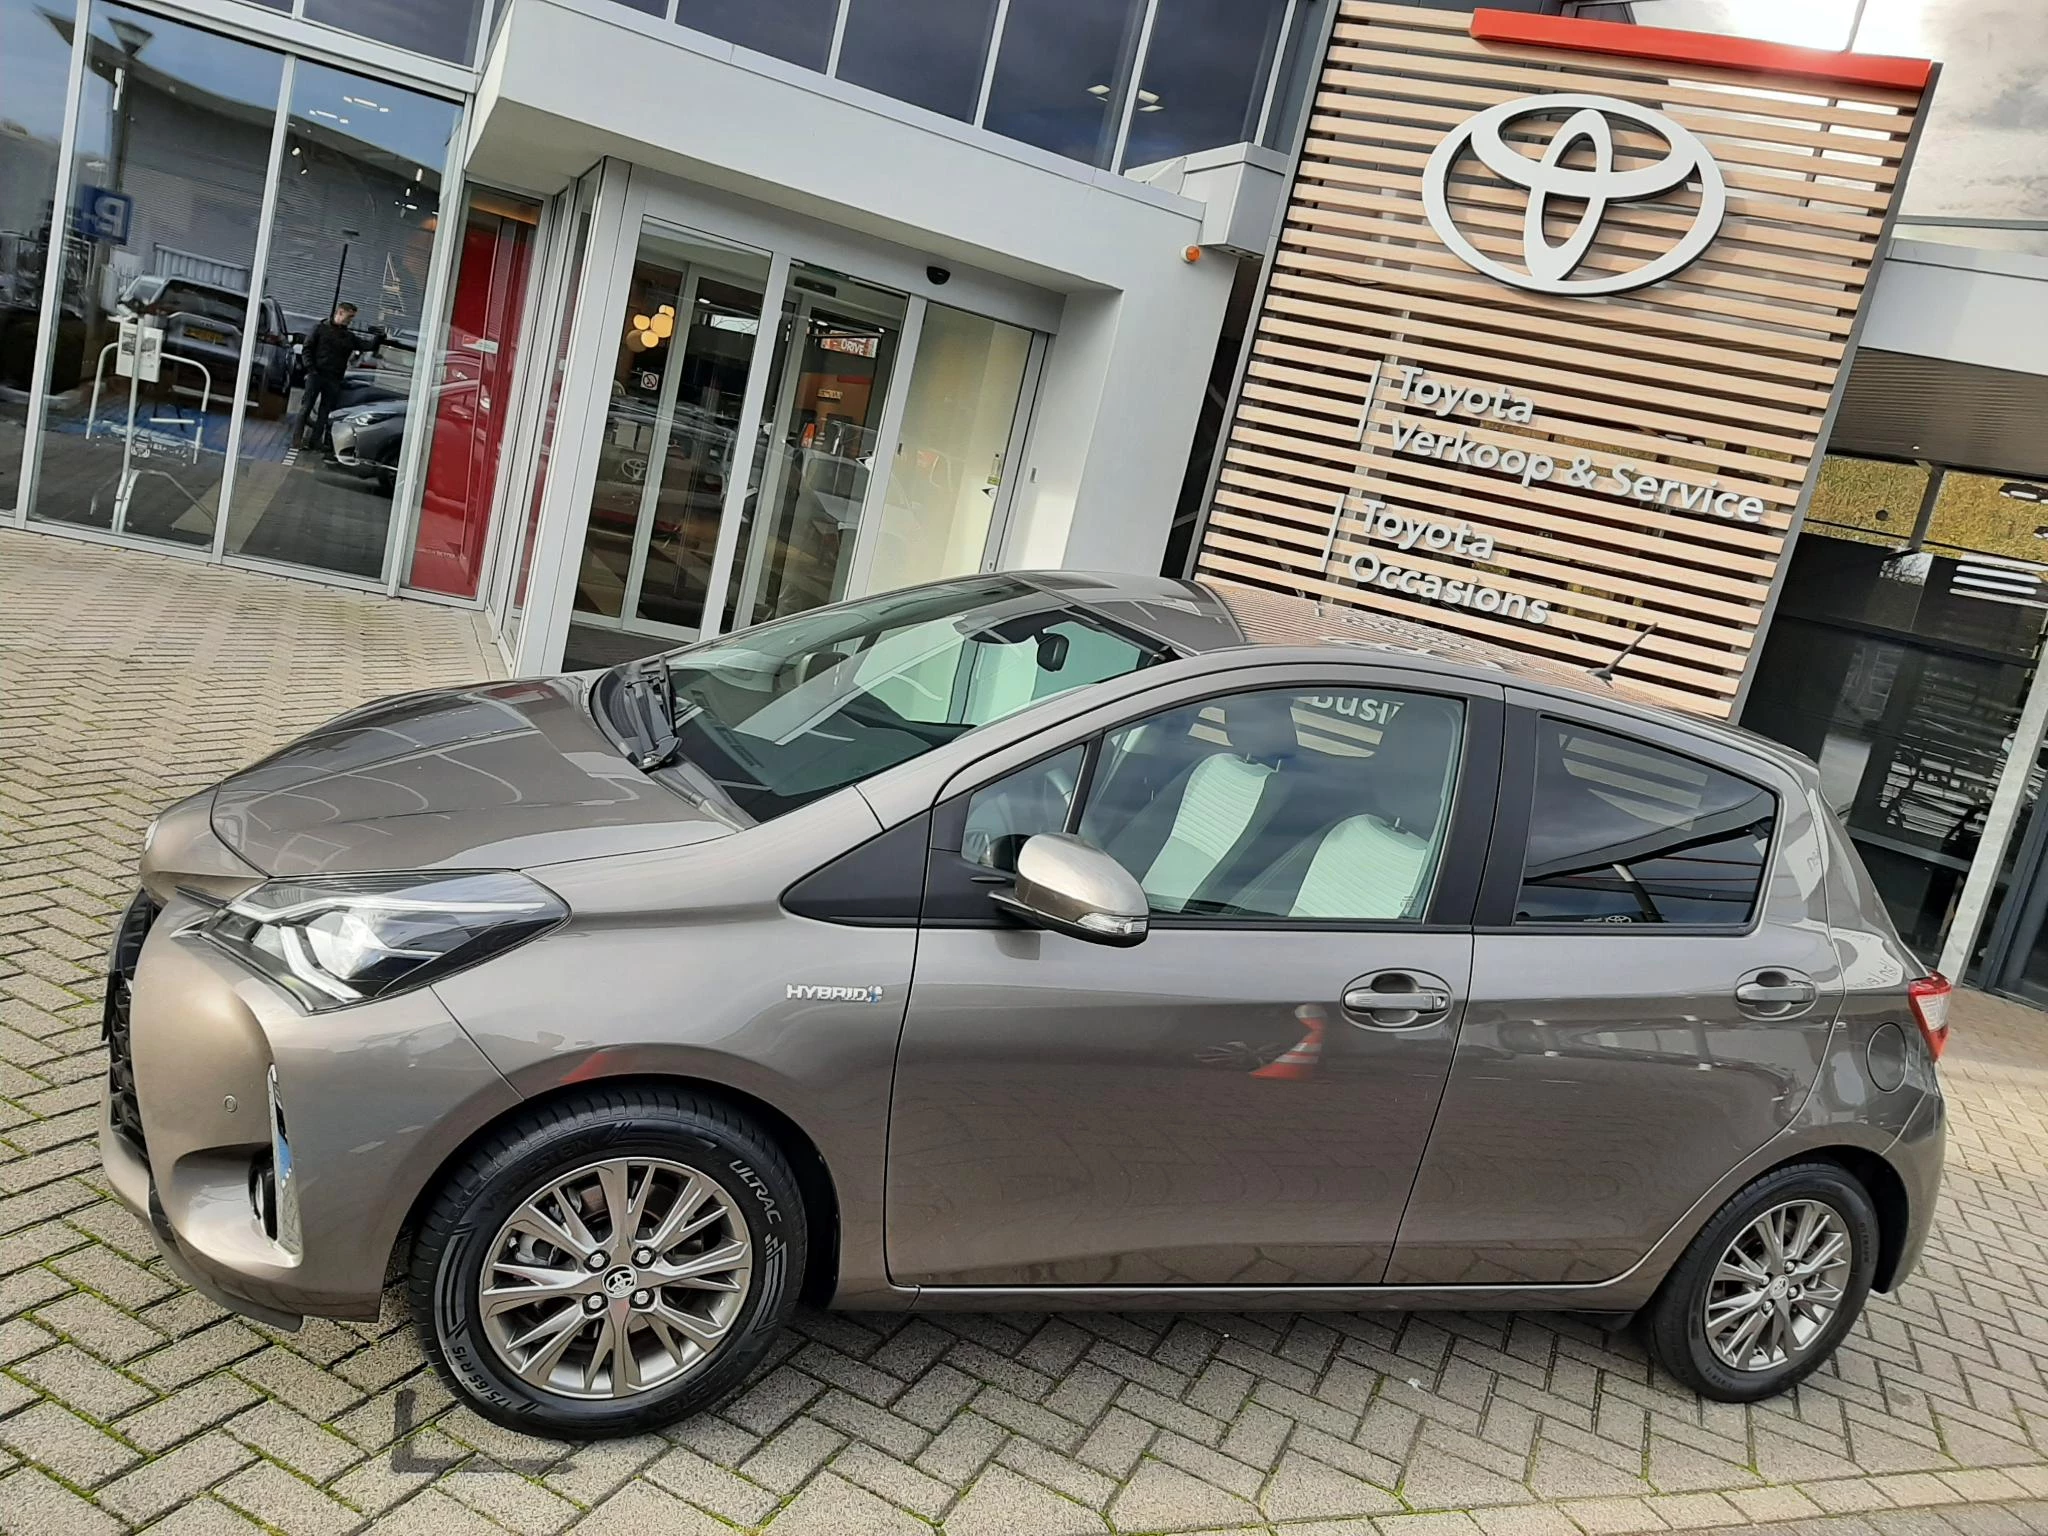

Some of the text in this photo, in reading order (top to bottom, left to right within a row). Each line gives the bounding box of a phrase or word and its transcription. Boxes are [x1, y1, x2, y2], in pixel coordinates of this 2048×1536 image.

[841, 339, 864, 356] DRIVE
[1400, 365, 1534, 424] Toyota
[1391, 419, 1764, 523] Verkoop & Service
[1362, 499, 1495, 559] Toyota
[1349, 552, 1549, 624] Occasions
[786, 984, 868, 1002] HYBRID
[728, 1159, 782, 1225] ULTRAC
[452, 1345, 512, 1408] 175/65 R 15
